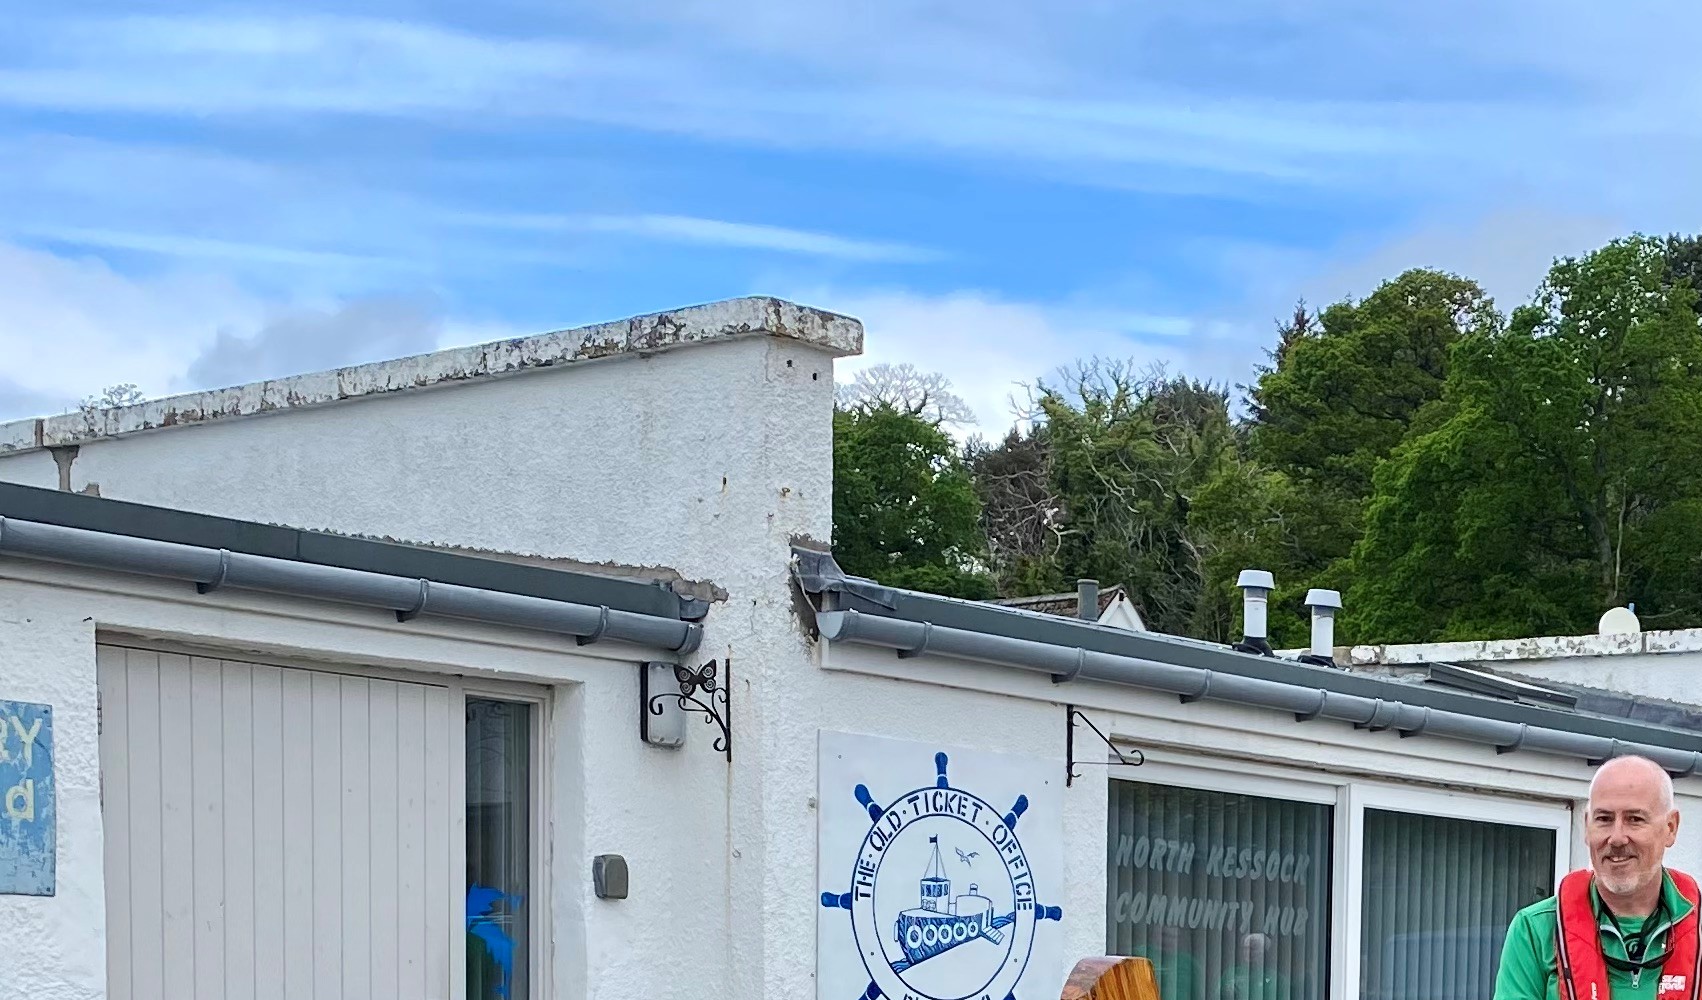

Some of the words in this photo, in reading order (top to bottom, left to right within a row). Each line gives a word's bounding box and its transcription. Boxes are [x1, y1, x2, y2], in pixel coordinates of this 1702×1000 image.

[855, 859, 876, 901] THE
[869, 810, 903, 851] OLD
[907, 790, 983, 823] TICKET
[992, 824, 1033, 911] OFFICE
[1115, 834, 1195, 874] NORTH
[1206, 844, 1310, 884] KESSOCK
[1115, 891, 1254, 933] COMMUNITY
[1263, 904, 1309, 936] HUB
